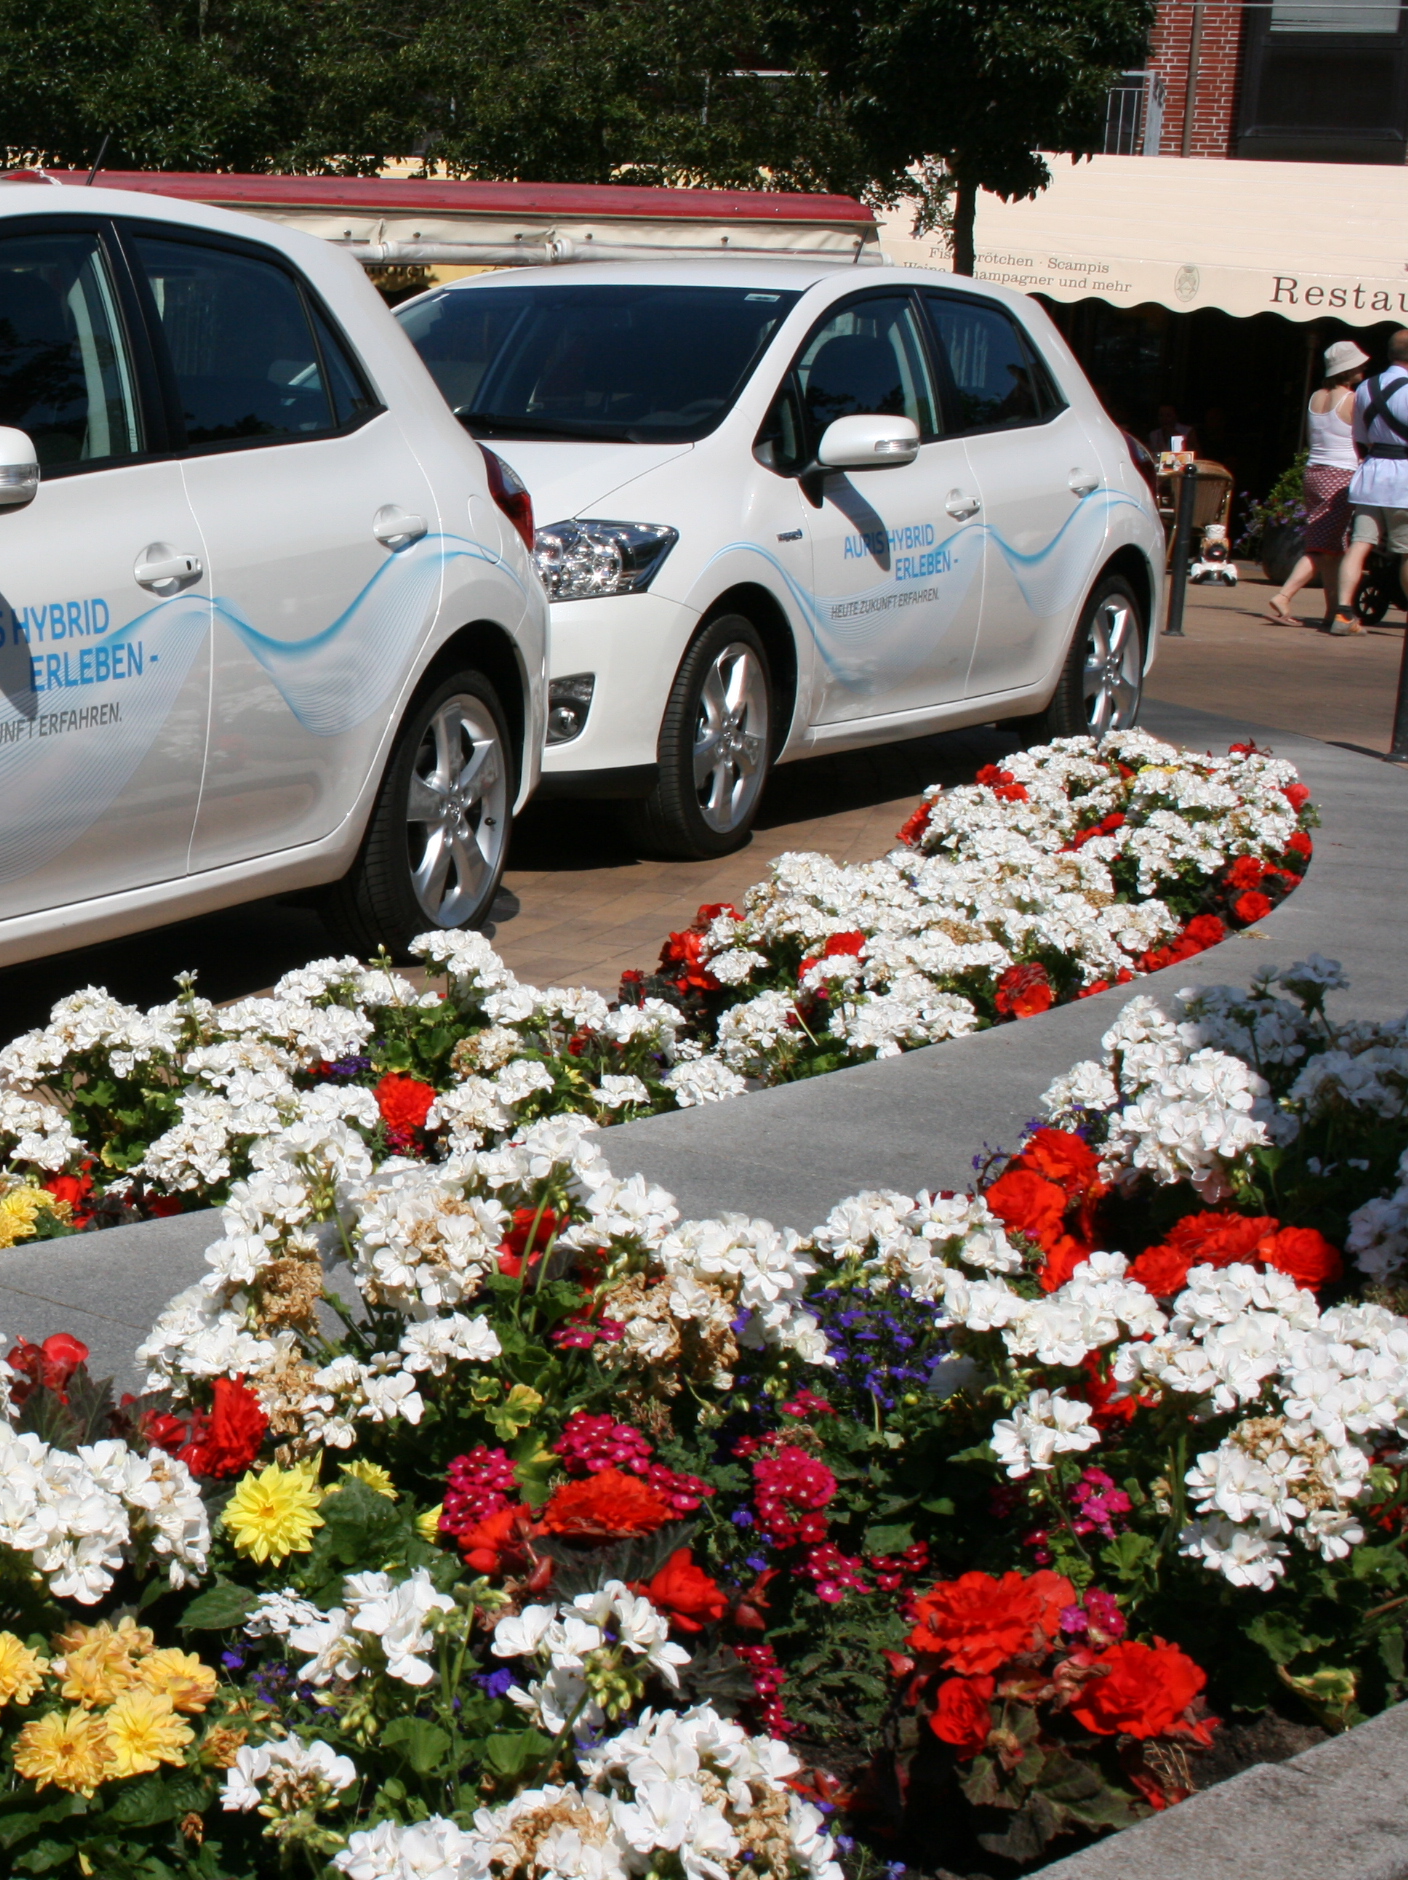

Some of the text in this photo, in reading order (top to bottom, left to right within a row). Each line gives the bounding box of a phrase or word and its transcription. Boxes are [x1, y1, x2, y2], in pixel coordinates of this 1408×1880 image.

[928, 247, 1034, 268] Fisrötchen
[1047, 258, 1110, 275] Scampis
[973, 269, 1133, 293] ampagner und mehr
[844, 523, 935, 560] AURIS HYBRID
[895, 550, 951, 581] ERLEBEN
[831, 587, 940, 619] HEUTE ZUKUNFT ERFAHREN.
[10, 598, 110, 645] HYBRID
[29, 641, 143, 692] ERLEBEN
[38, 702, 123, 737] ERFAHREN.
